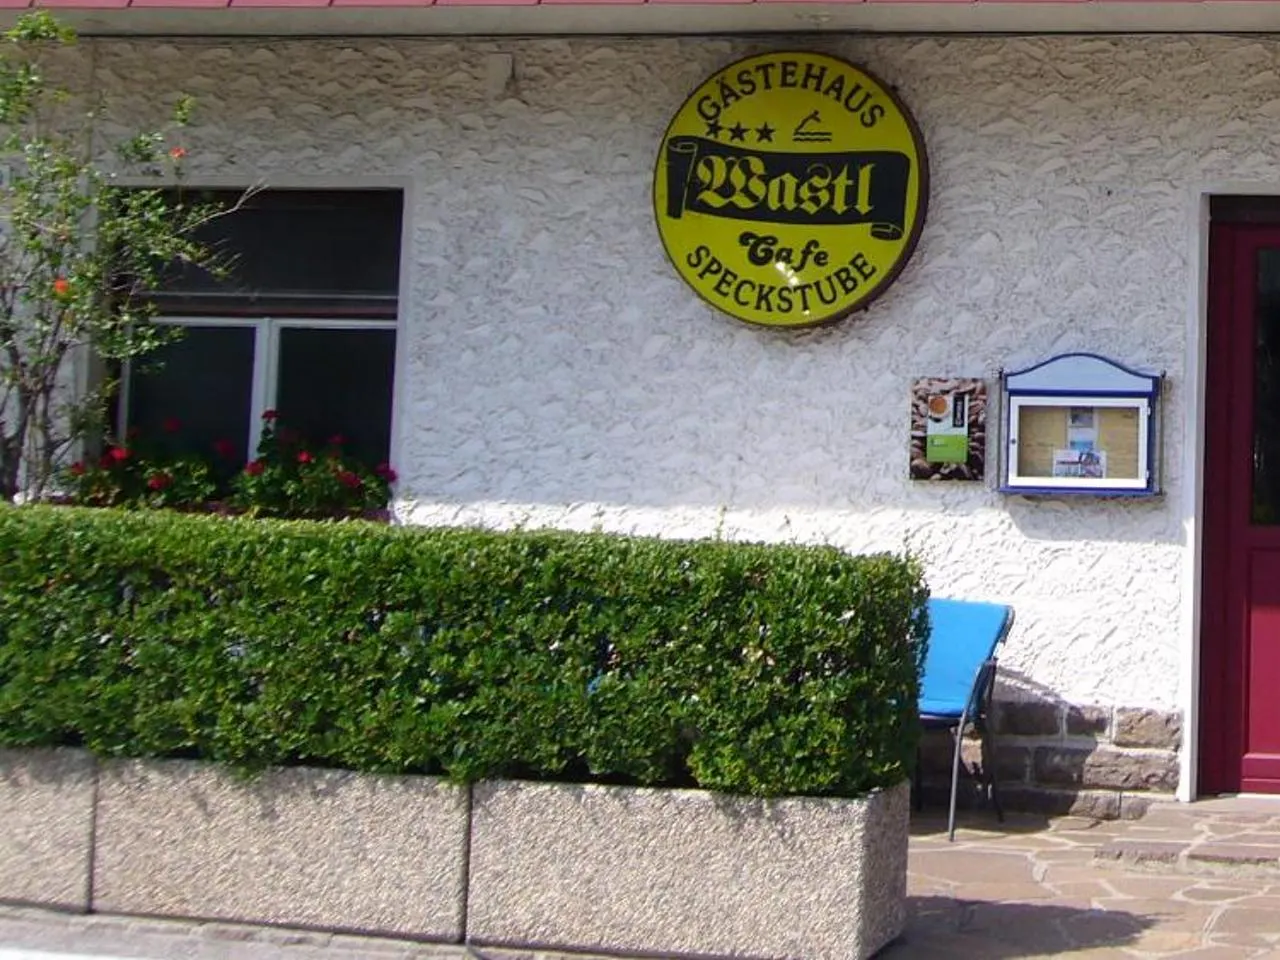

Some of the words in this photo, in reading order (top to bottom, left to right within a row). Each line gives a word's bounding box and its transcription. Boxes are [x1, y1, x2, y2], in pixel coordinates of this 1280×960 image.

[696, 61, 884, 128] GÄSTEHAUS
[696, 155, 876, 215] Wastl
[686, 245, 877, 313] SPECKSTUBE
[738, 231, 829, 272] Cafe
